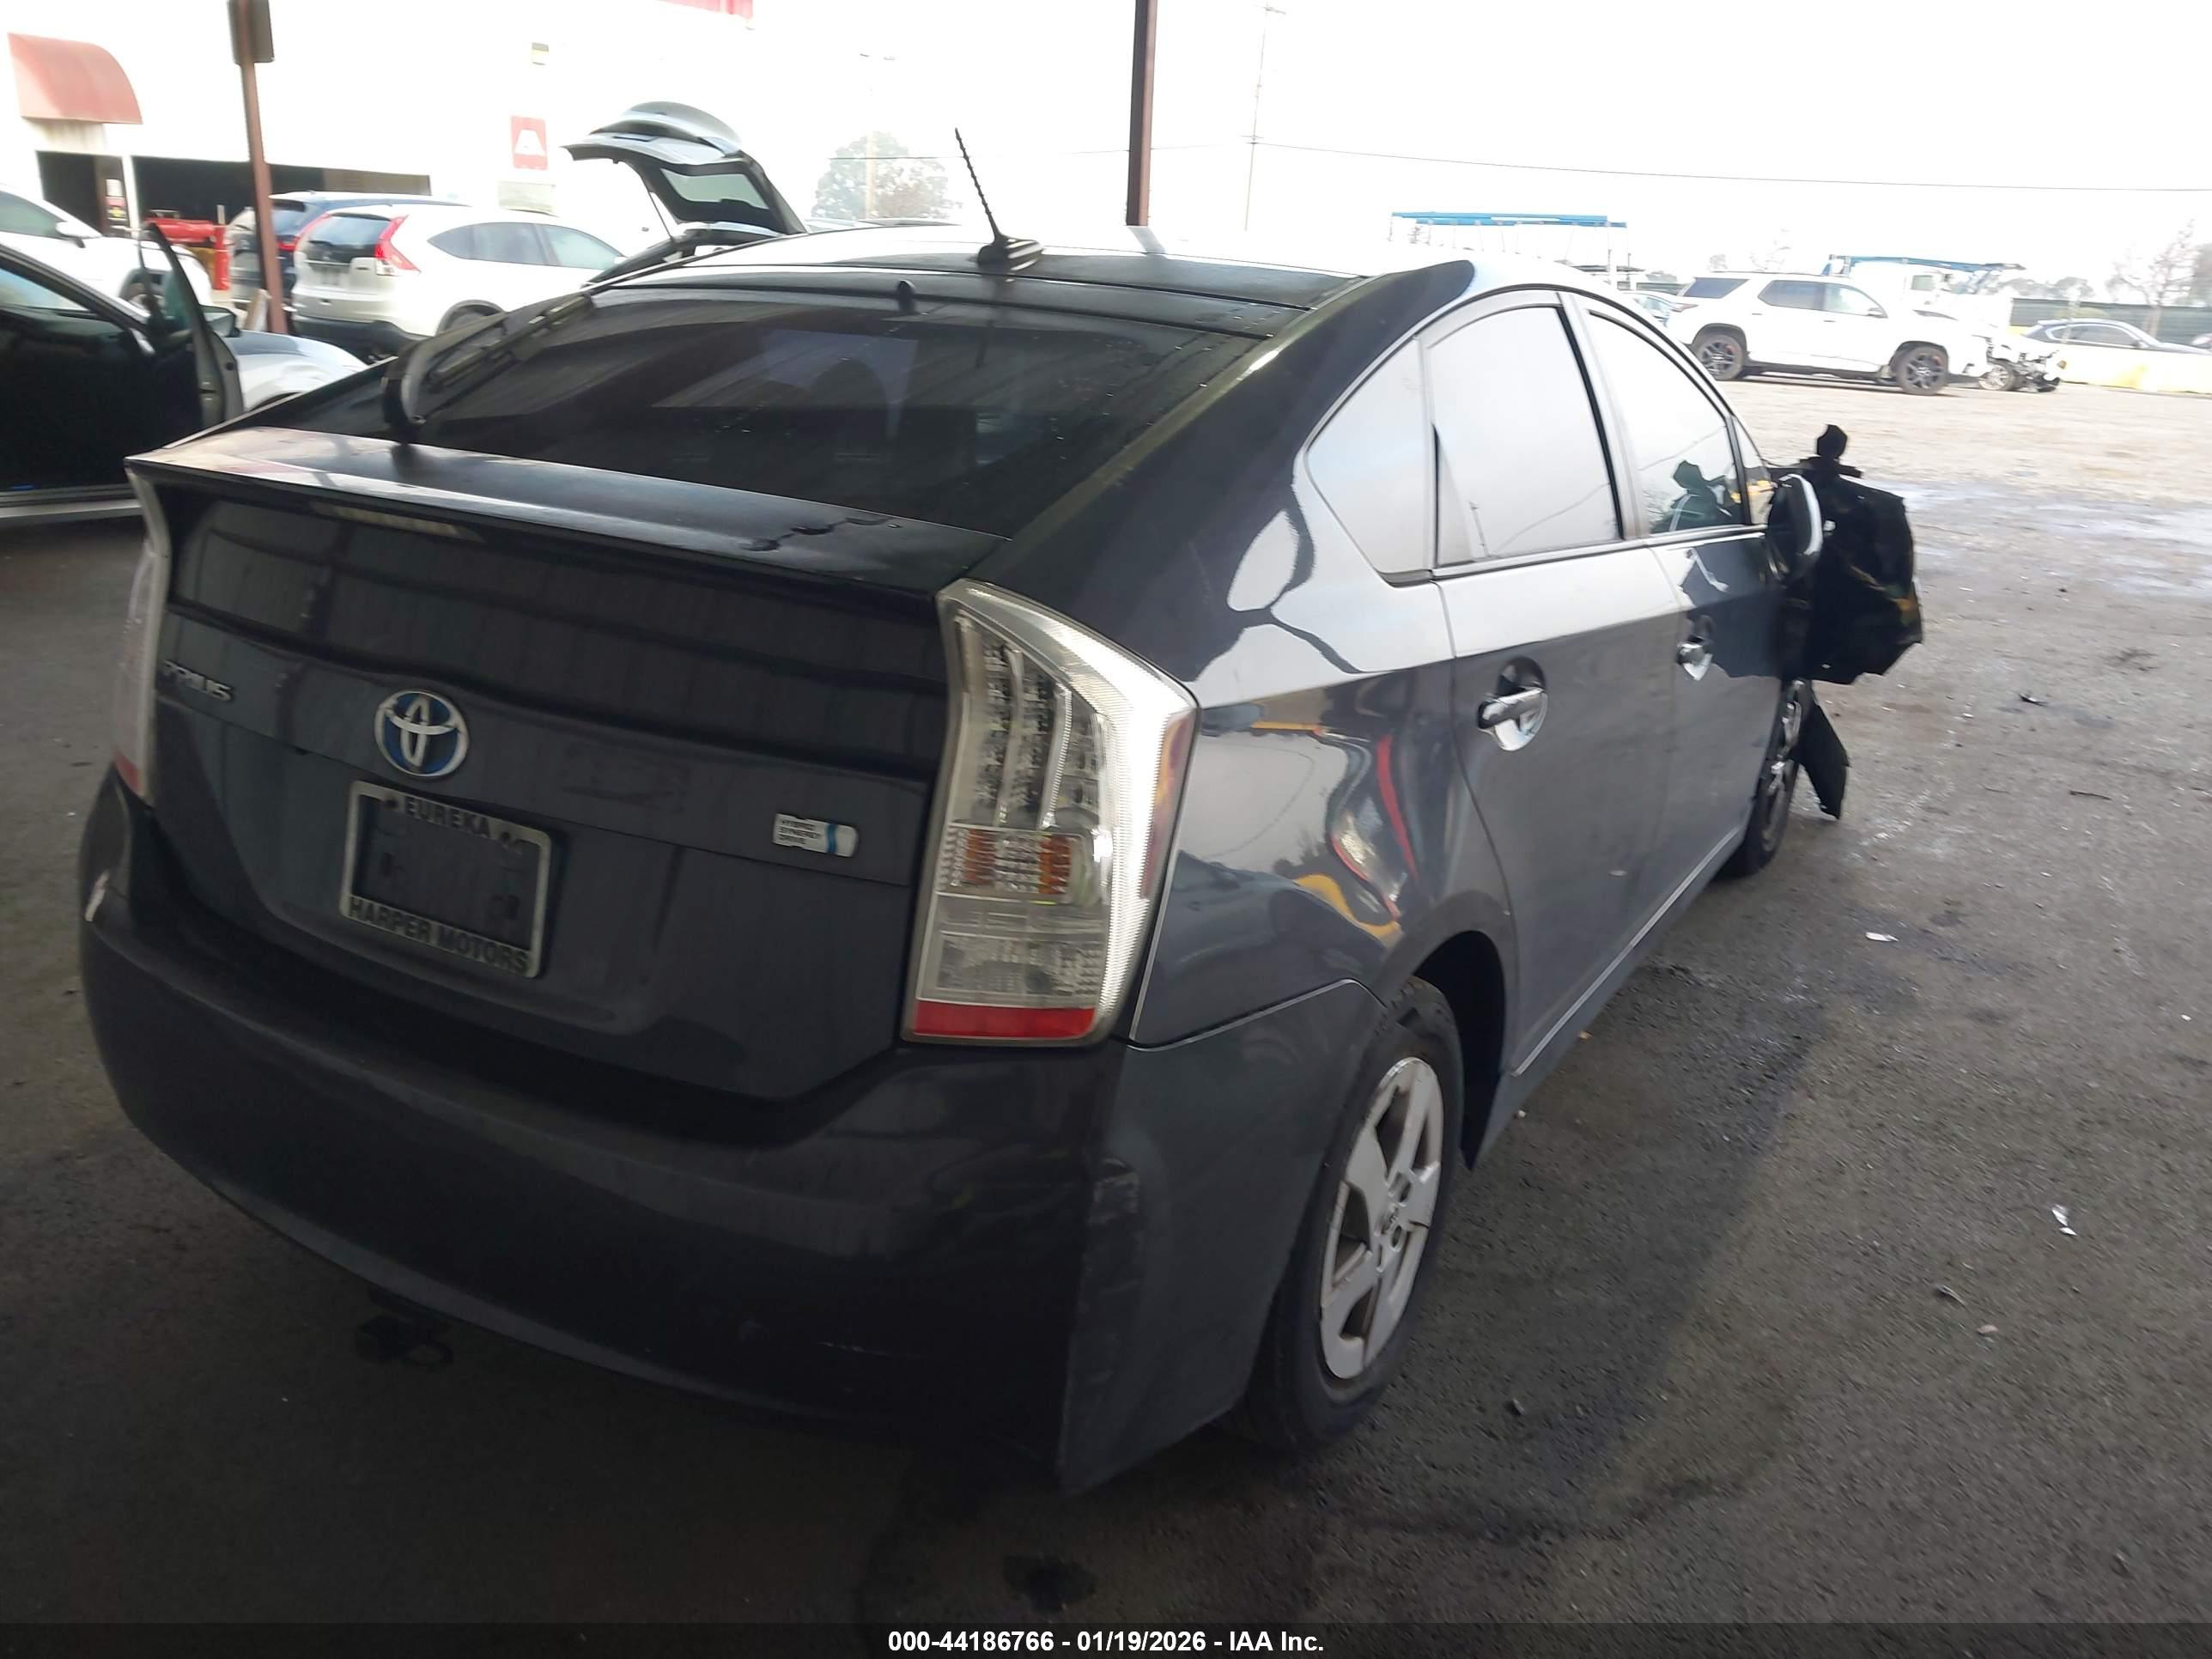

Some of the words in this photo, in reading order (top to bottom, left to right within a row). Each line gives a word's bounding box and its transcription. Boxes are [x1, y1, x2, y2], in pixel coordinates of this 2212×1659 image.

[405, 795, 491, 839] EUREKA
[348, 896, 430, 945] HARPER
[436, 923, 529, 975] MOTORS
